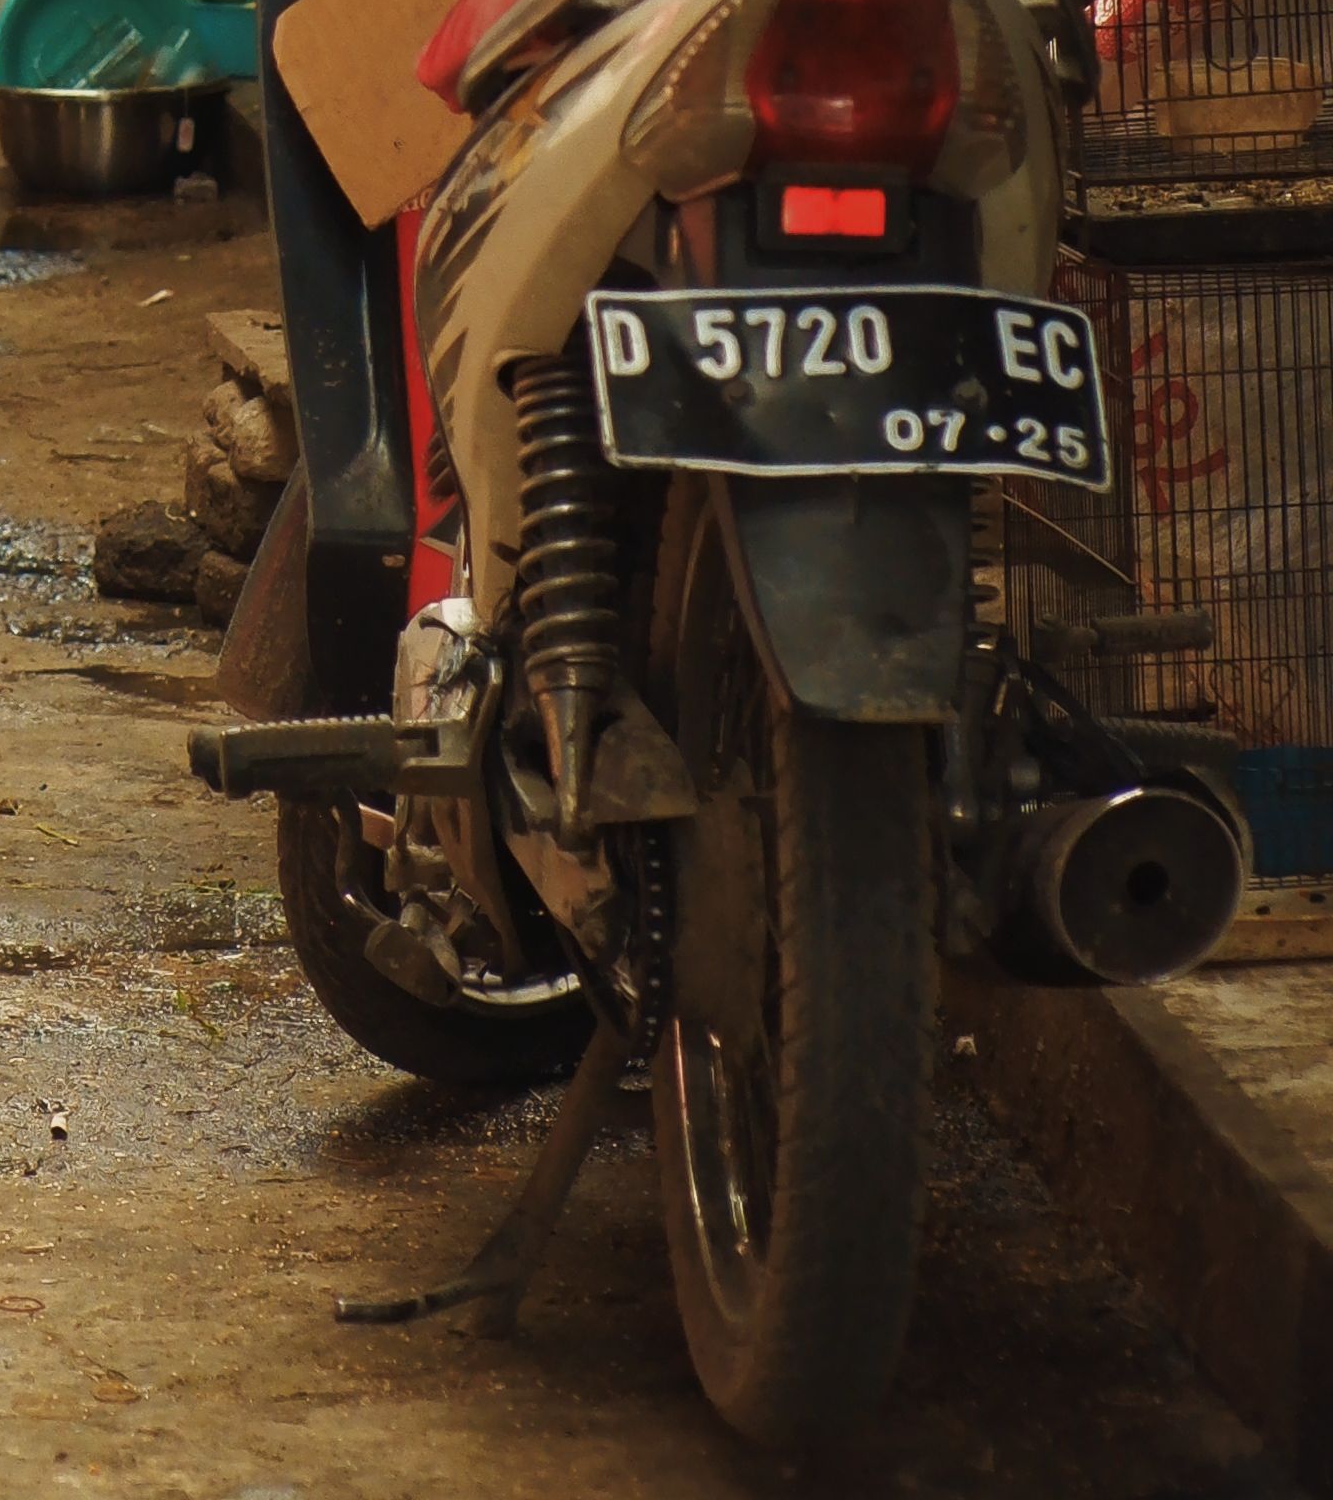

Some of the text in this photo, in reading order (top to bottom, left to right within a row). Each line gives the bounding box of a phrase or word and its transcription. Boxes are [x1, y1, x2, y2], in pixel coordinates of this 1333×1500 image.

[603, 305, 1086, 390] D 5720 EC
